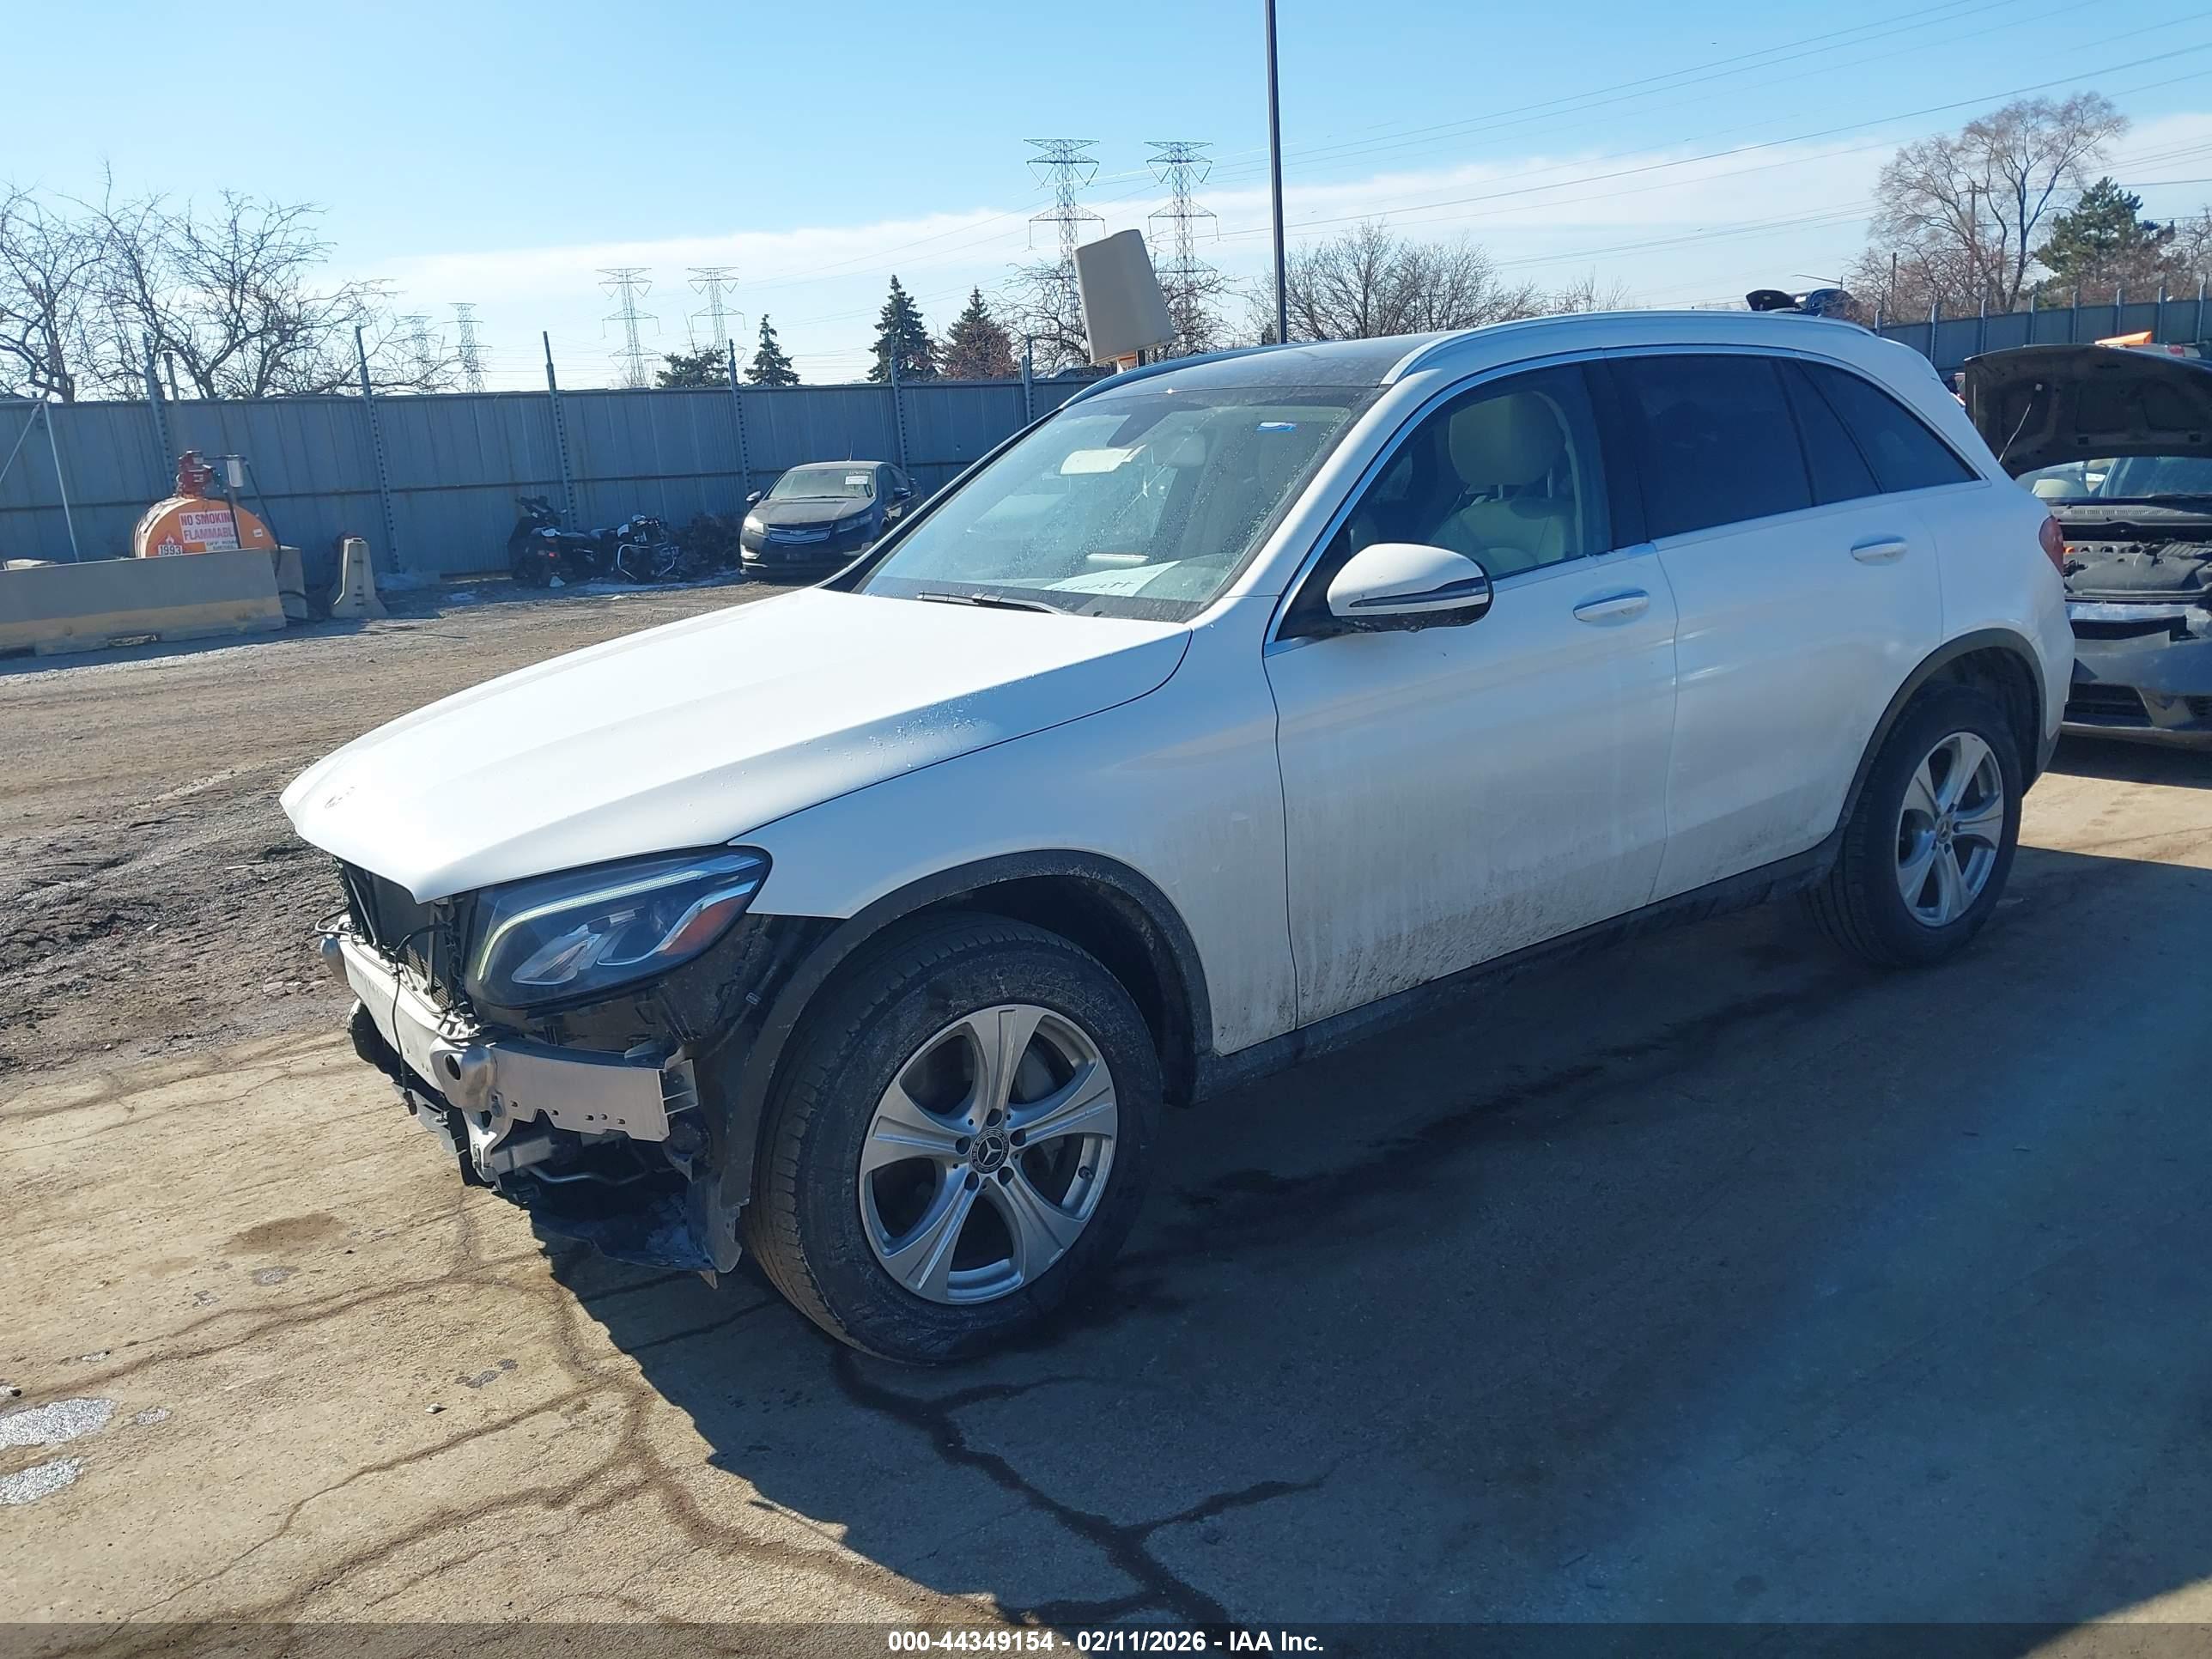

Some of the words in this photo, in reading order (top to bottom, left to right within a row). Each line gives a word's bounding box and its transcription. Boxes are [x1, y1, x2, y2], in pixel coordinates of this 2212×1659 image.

[180, 514, 193, 526] NO
[195, 512, 231, 525] SMOKIN
[184, 527, 234, 540] FLAMMABL
[161, 545, 181, 556] 1993
